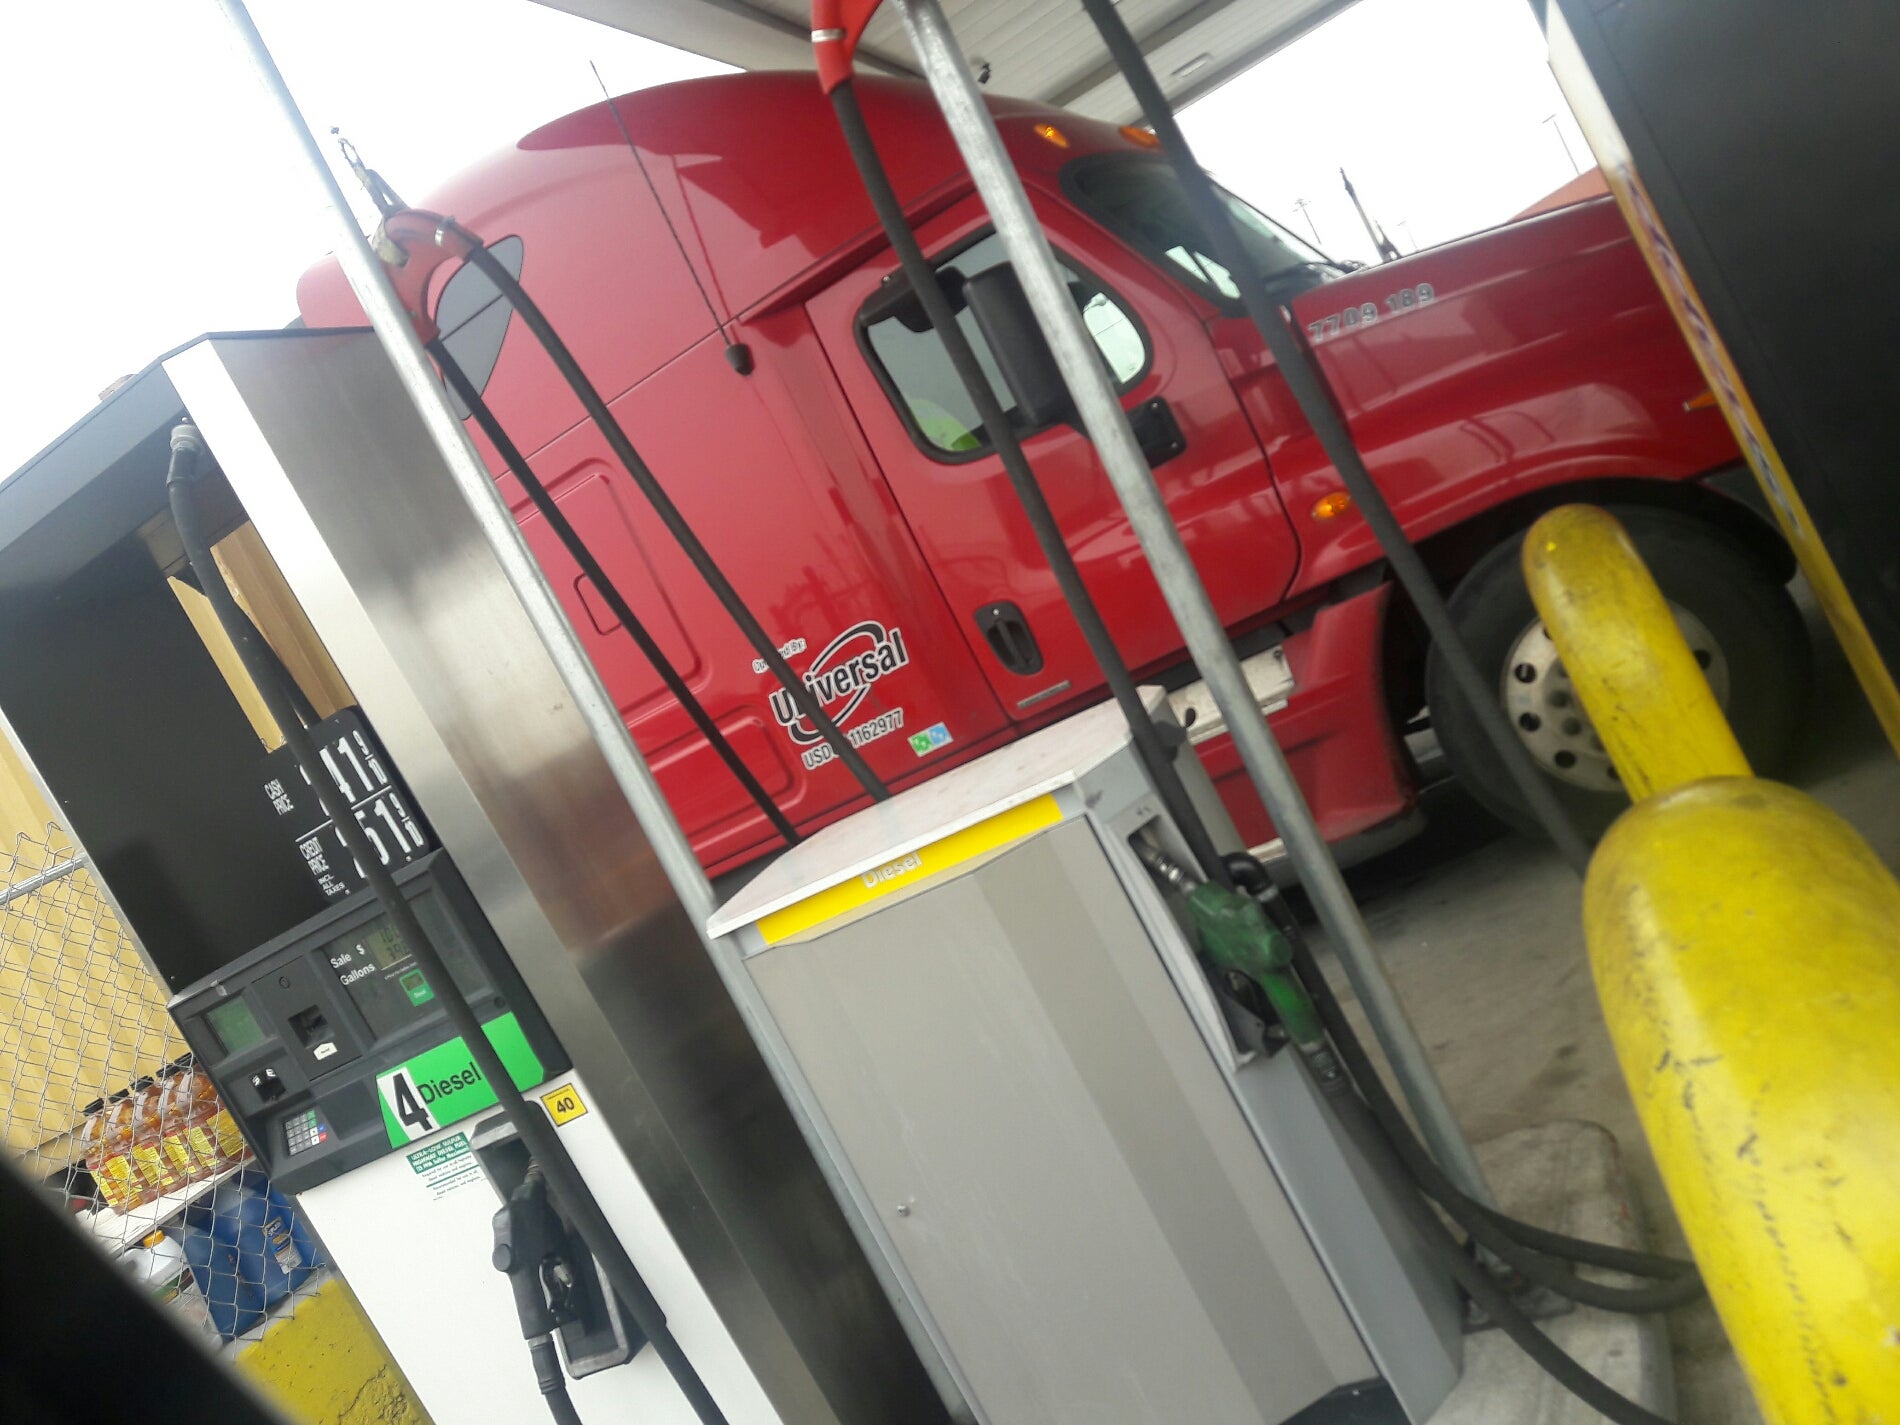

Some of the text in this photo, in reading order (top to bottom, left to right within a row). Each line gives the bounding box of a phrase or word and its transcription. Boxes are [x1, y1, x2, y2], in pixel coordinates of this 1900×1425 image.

[1308, 283, 1435, 343] 7709 189
[770, 630, 907, 725] Uiversal
[850, 709, 903, 747] 1162977
[264, 778, 285, 801] CASH
[272, 793, 294, 816] PRICE
[300, 836, 323, 861] CREDIT
[308, 853, 330, 876] PRICE
[862, 851, 923, 889] Diesel
[325, 882, 346, 897] TAXES
[330, 952, 352, 969] Sale
[340, 963, 375, 986] Gallons
[392, 1062, 482, 1132] 4 Diesel
[556, 1096, 576, 1114] 40
